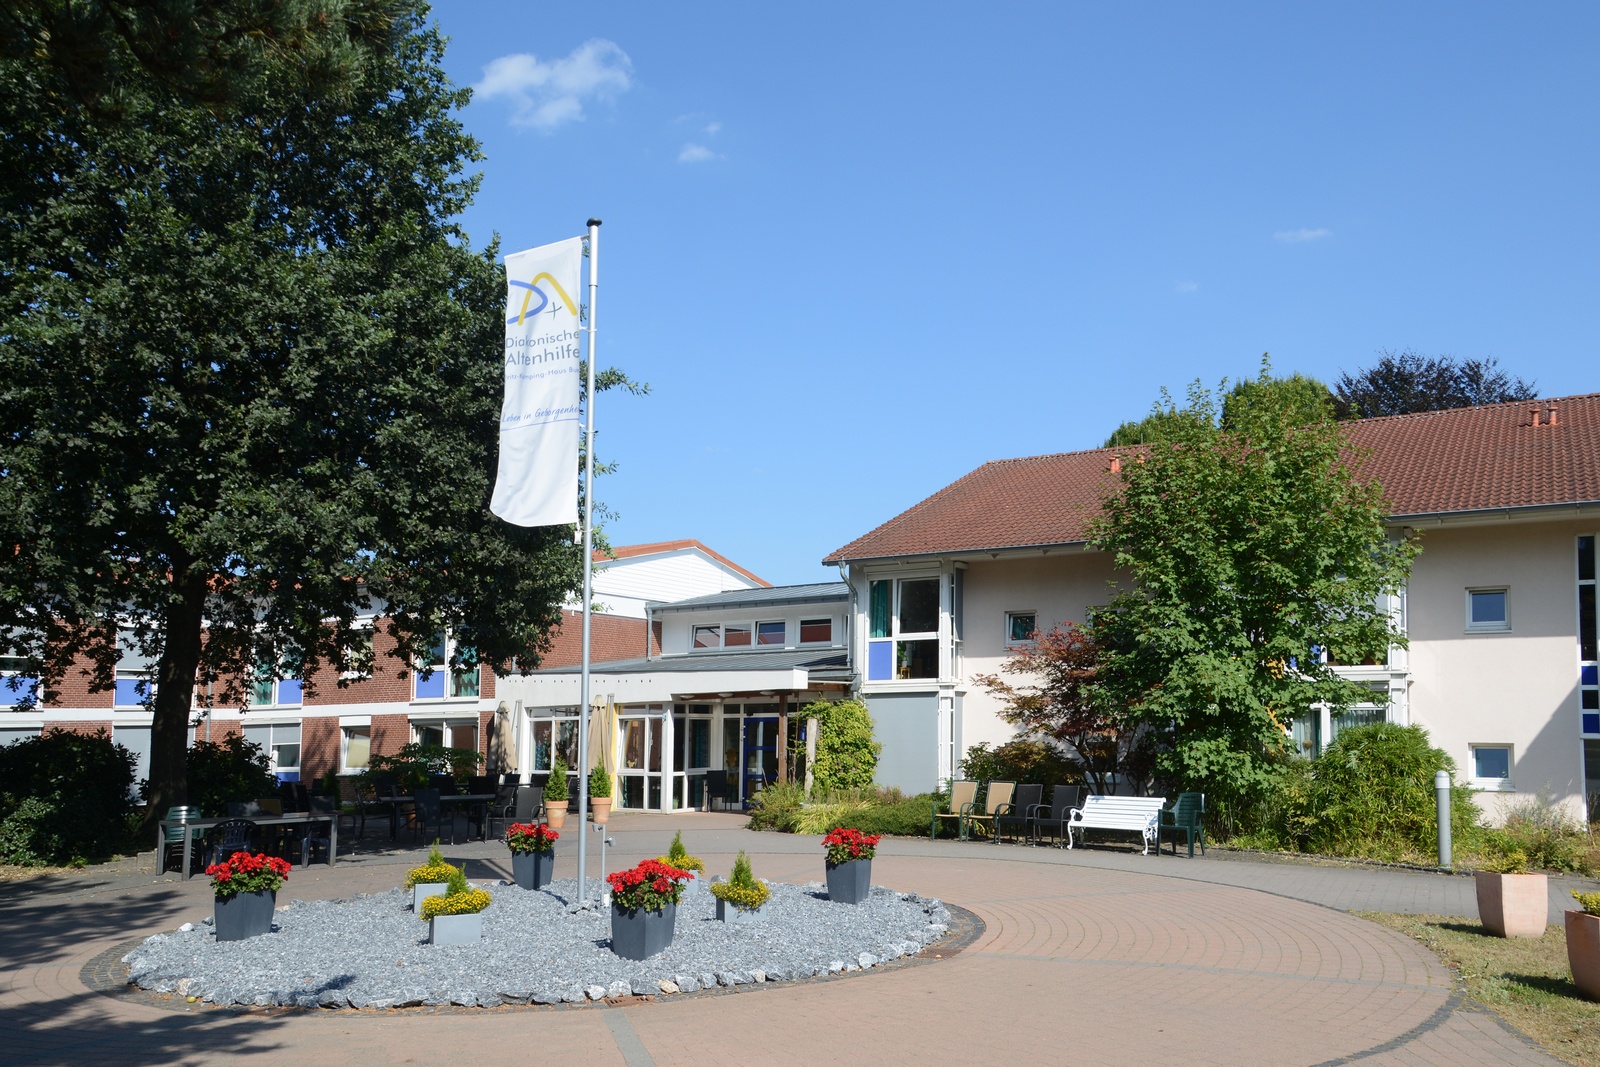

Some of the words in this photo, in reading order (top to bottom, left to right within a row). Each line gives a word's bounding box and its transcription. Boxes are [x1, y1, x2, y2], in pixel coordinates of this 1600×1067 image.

[505, 330, 579, 348] Diakonische
[505, 344, 579, 366] Altenhilfe
[502, 413, 521, 422] Leben
[535, 404, 579, 420] Geborgenhe
